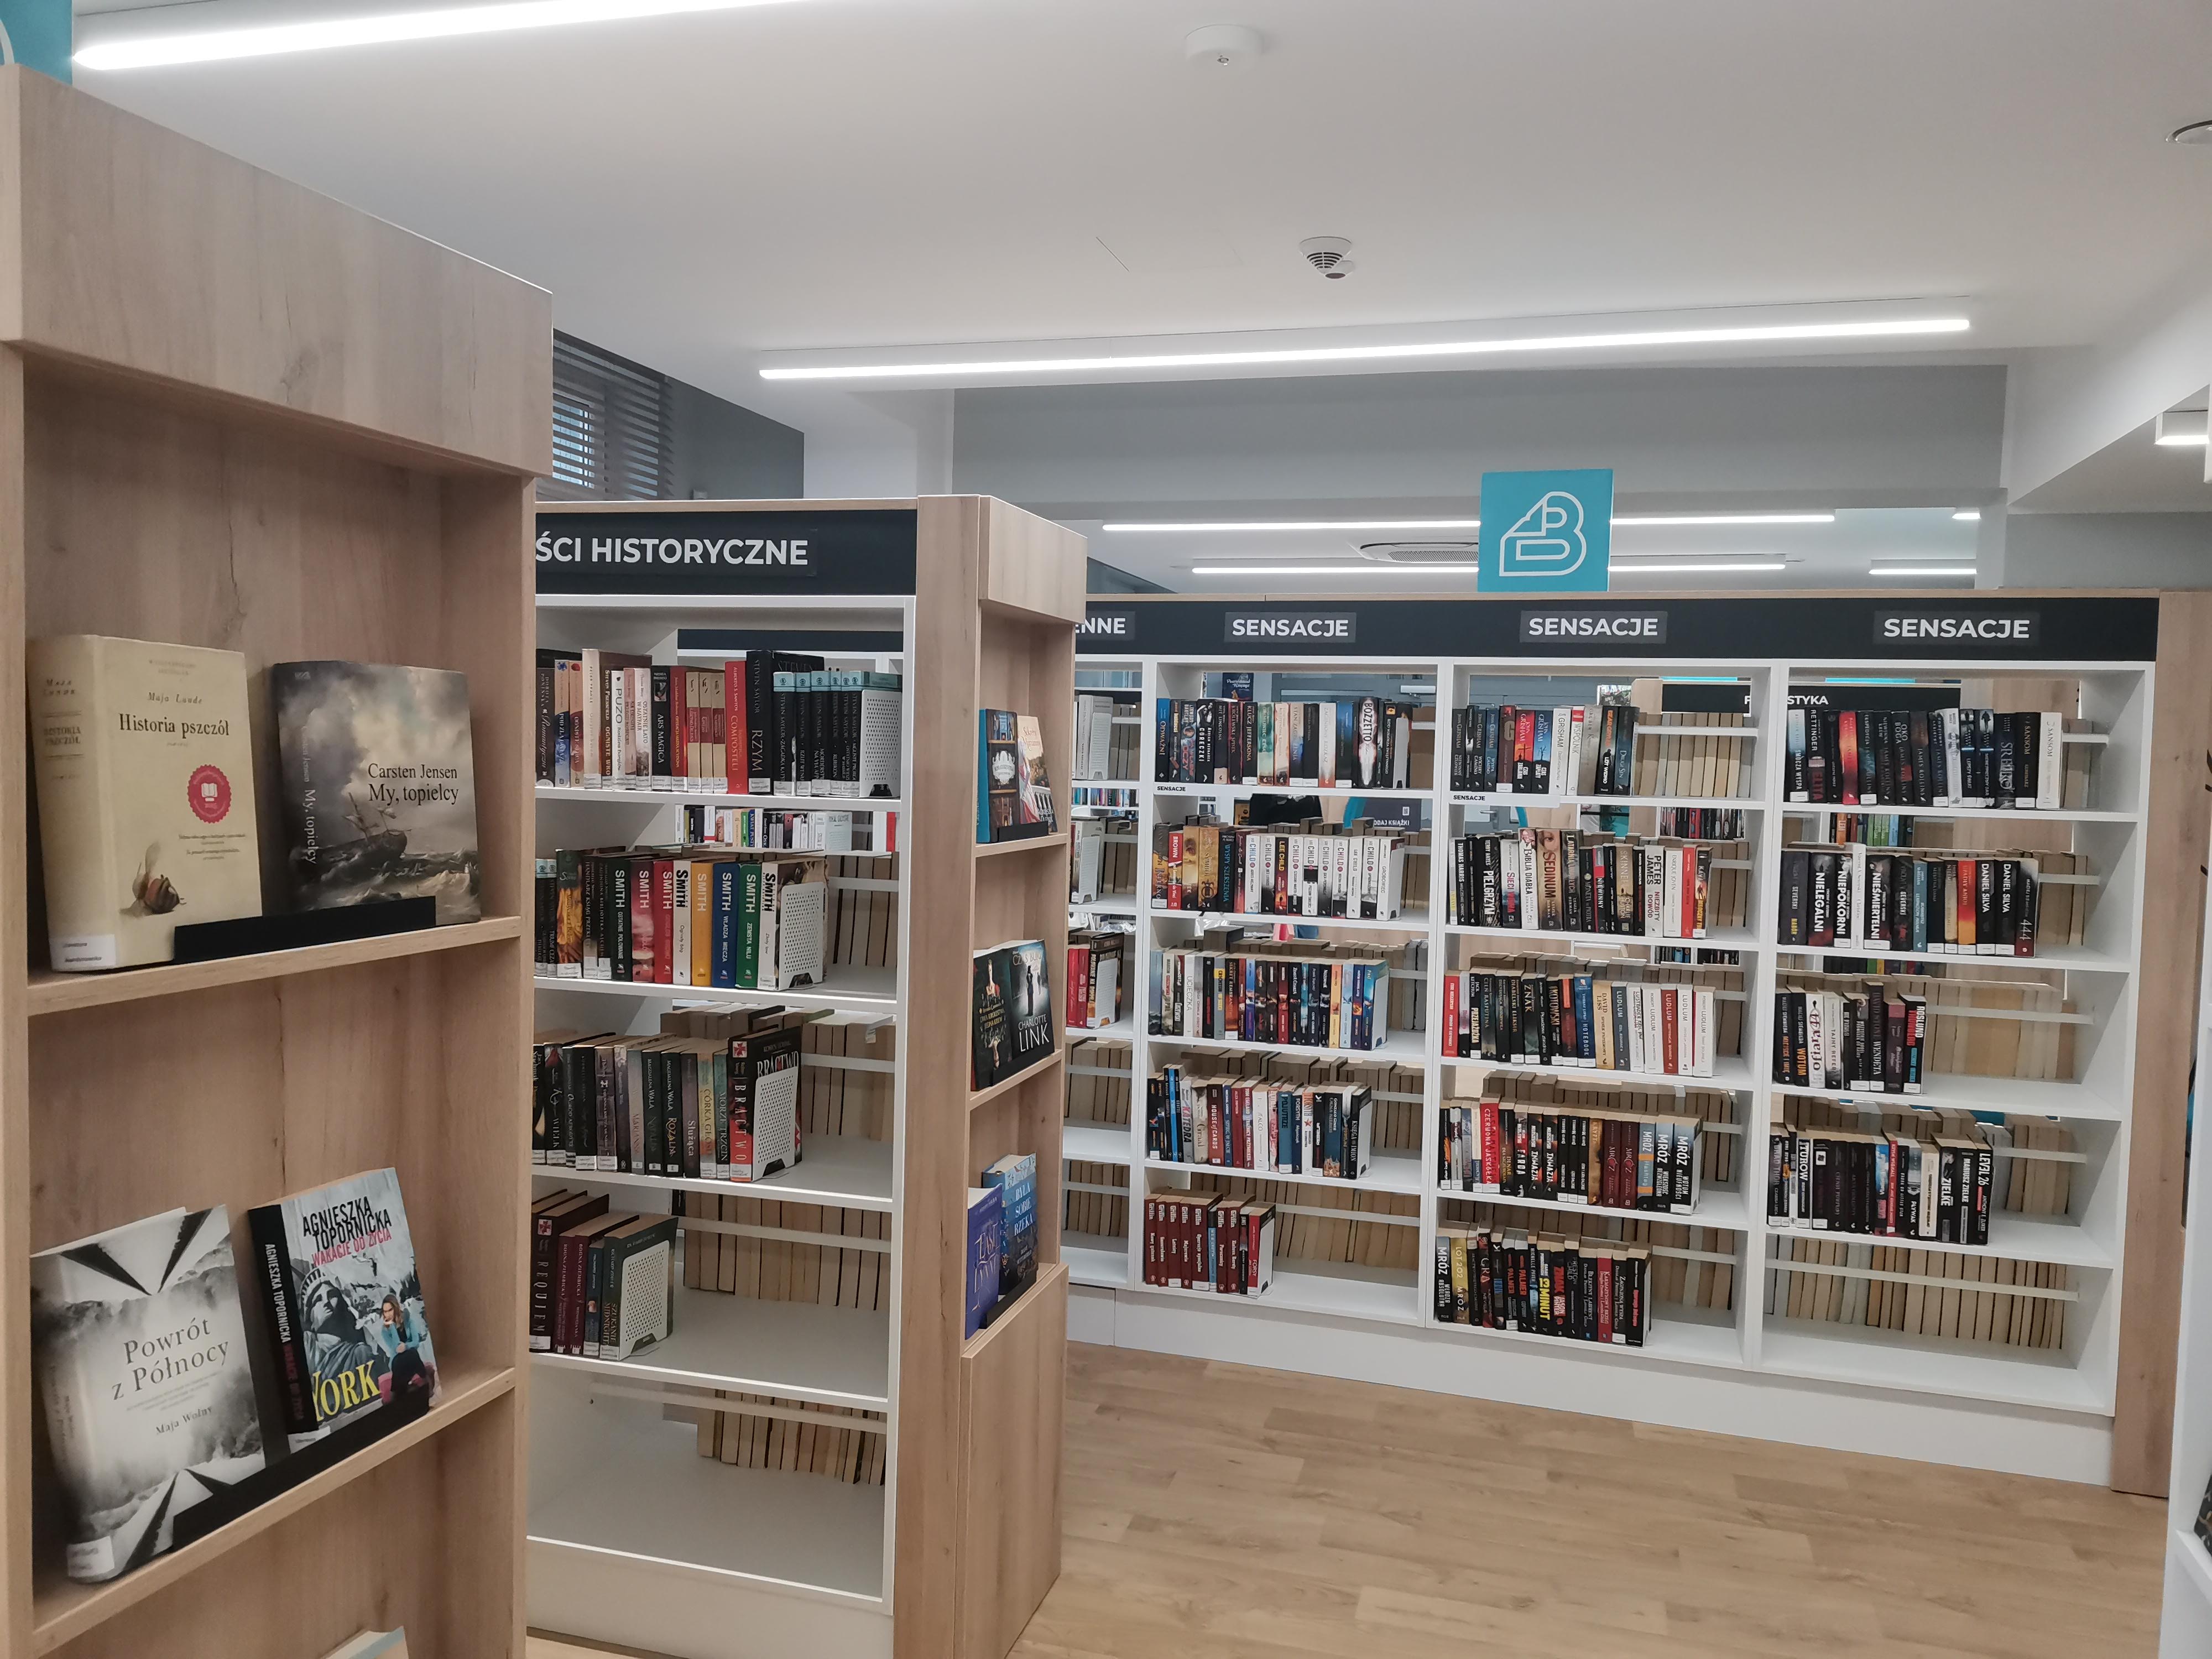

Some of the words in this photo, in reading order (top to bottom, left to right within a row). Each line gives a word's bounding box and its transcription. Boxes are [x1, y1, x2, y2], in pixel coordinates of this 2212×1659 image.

[592, 538, 808, 565] HISTORYCZNE
[1233, 619, 1349, 636] SENSACJE
[1528, 618, 1658, 635] SENSACJE
[1884, 619, 2030, 638] SENSACJE
[148, 692, 169, 704] Maja
[176, 694, 203, 705] Lunde
[118, 712, 176, 733] Historia
[181, 719, 230, 739] pszczół
[658, 714, 667, 728] ARS
[1364, 703, 1373, 742] BOZZETTO
[658, 731, 667, 763] MAGICA
[752, 729, 763, 771] RZYM
[368, 763, 416, 778] Carsten
[420, 764, 457, 779] Jensen
[368, 784, 399, 806] My,
[403, 784, 458, 806] topielcy
[302, 816, 320, 864] topielcy
[1524, 848, 1532, 870] BIBLIA
[1543, 852, 1556, 898] SEDINUM
[615, 870, 625, 907] SMITH
[639, 870, 649, 909] SMITH
[662, 871, 672, 910] SMITH
[676, 870, 688, 907] SMITH
[697, 873, 706, 911] SMITH
[722, 873, 732, 911] SMITH
[745, 874, 756, 912] SMITH
[764, 873, 776, 912] SMITH
[1483, 871, 1494, 915] PIELGRZYM
[1507, 872, 1515, 889] SIECI
[1981, 864, 1990, 891] DANIEL
[2003, 864, 2011, 891] DANIEL
[1814, 872, 1825, 932] NIELEGALNI
[1837, 870, 1846, 934] NIEPOKORNI
[2019, 919, 2032, 940] 444
[1018, 1014, 1046, 1030] CHARLOTTE
[1020, 1024, 1050, 1052] LINK
[1797, 1048, 1806, 1075] WOTUM
[1873, 1041, 1881, 1074] WENDETA
[686, 1120, 696, 1156] Służąca
[734, 1084, 748, 1160] BRACTWO
[1182, 1106, 1192, 1142] KATEDRA
[1643, 1131, 1653, 1151] MRÓZ
[1657, 1134, 1670, 1163] MRÓZ
[1677, 1136, 1690, 1166] MRÓZ
[1799, 1145, 1808, 1181] TUROW
[1015, 1182, 1030, 1201] BYŁA
[1941, 1178, 1951, 1206] ZIELKE
[1978, 1177, 1989, 1185] 26
[303, 1196, 372, 1237] AGNIESZKA
[1015, 1198, 1032, 1218] SOBIE
[312, 1208, 392, 1252] TOPORNICKA
[1014, 1215, 1034, 1236] RZEKA
[264, 1244, 283, 1290] AGNIESZKA
[312, 1241, 351, 1267] WAKACJE
[353, 1237, 365, 1253] OD
[1438, 1247, 1449, 1275] MRÓZ
[1480, 1258, 1490, 1283] GRA
[534, 1261, 550, 1331] REQUIEM
[1540, 1288, 1550, 1320] MINUT
[273, 1291, 291, 1343] TOPORNICKA
[123, 1317, 210, 1365] Powrót
[112, 1382, 124, 1400] z
[132, 1341, 228, 1392] Północy
[312, 1359, 380, 1421] YORK
[156, 1420, 179, 1434] Maja
[182, 1406, 212, 1423] Wolny
